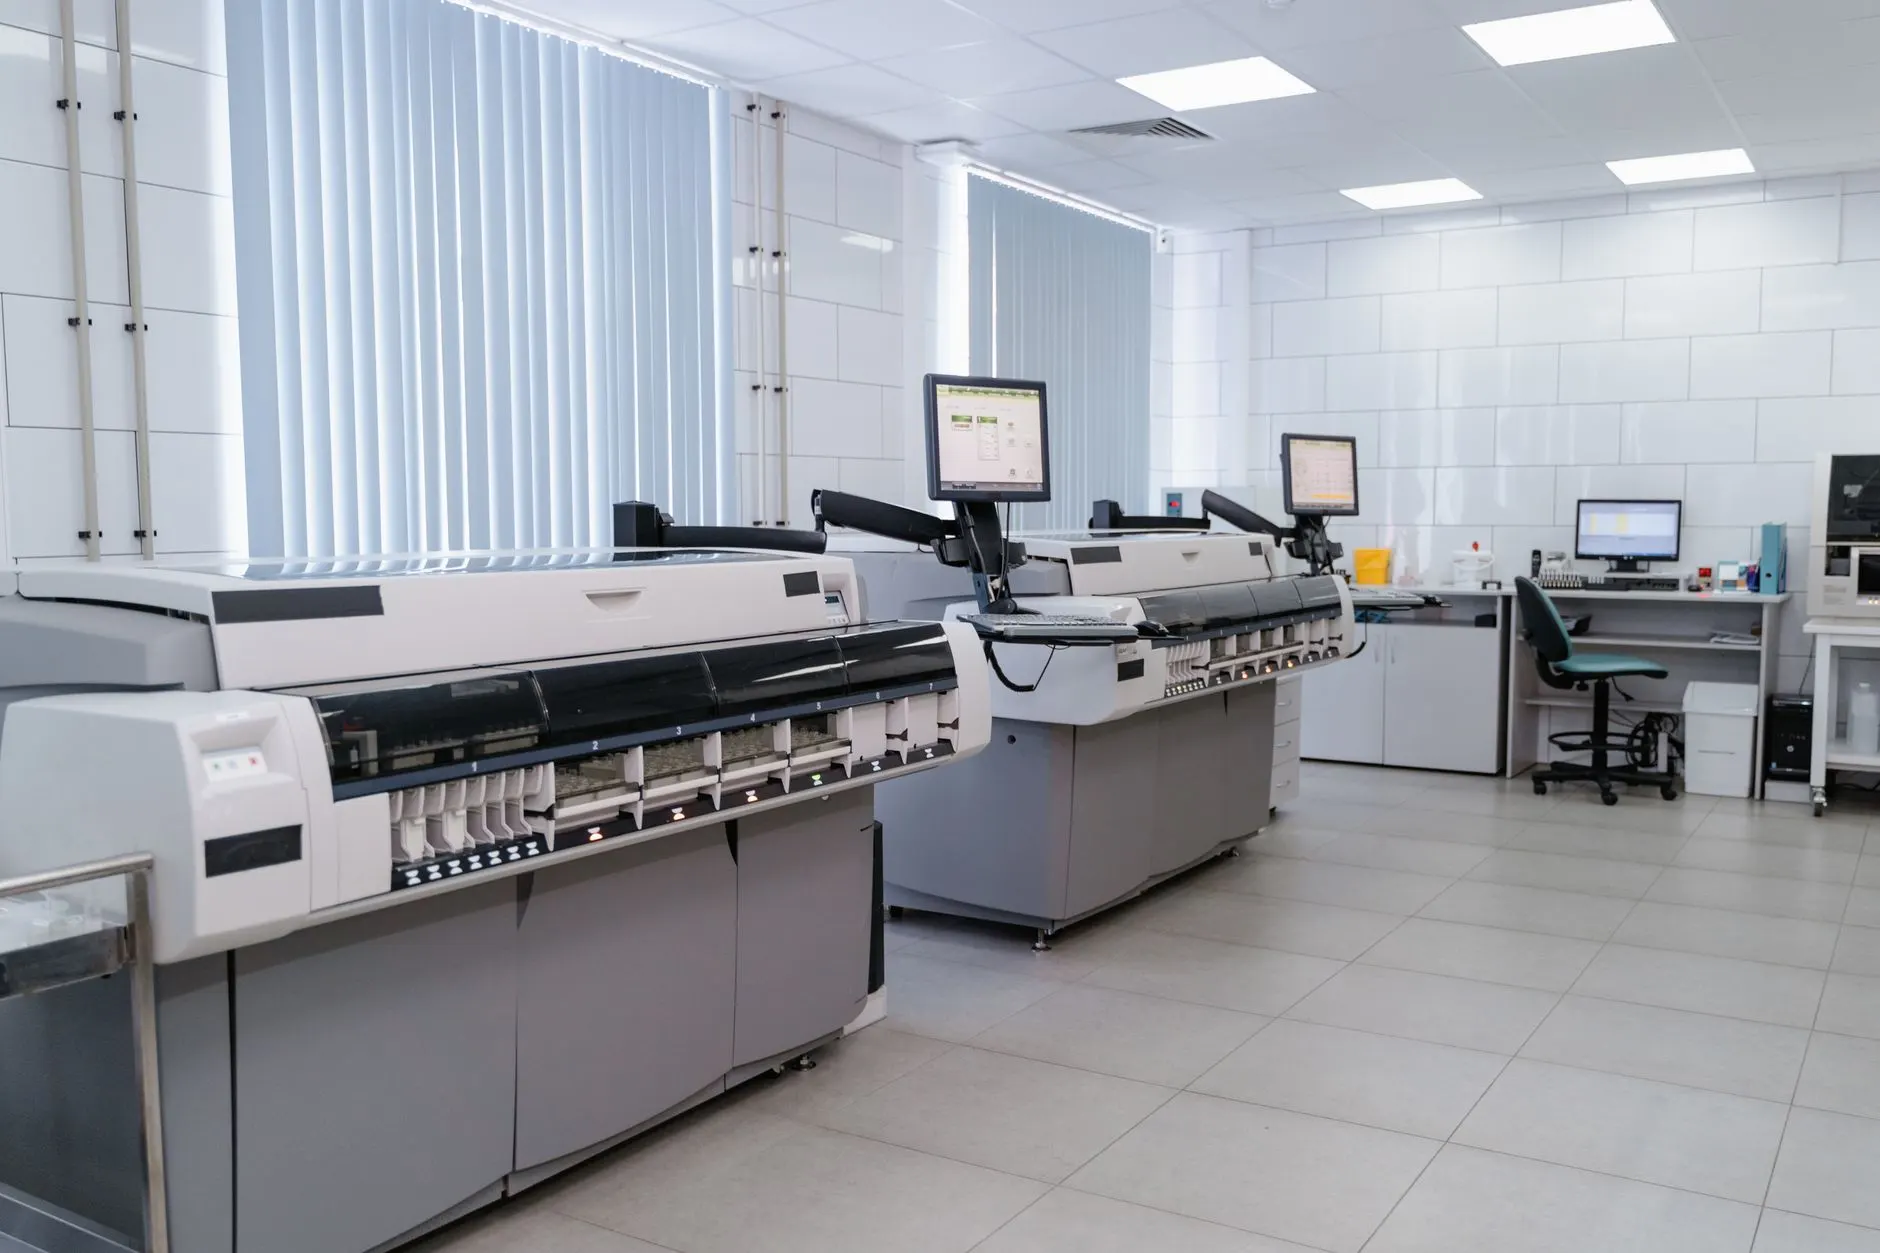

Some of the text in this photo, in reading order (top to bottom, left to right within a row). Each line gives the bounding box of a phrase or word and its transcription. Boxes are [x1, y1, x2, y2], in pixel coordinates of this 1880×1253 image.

[472, 682, 933, 772] 1 2 3 4 5 6 7
